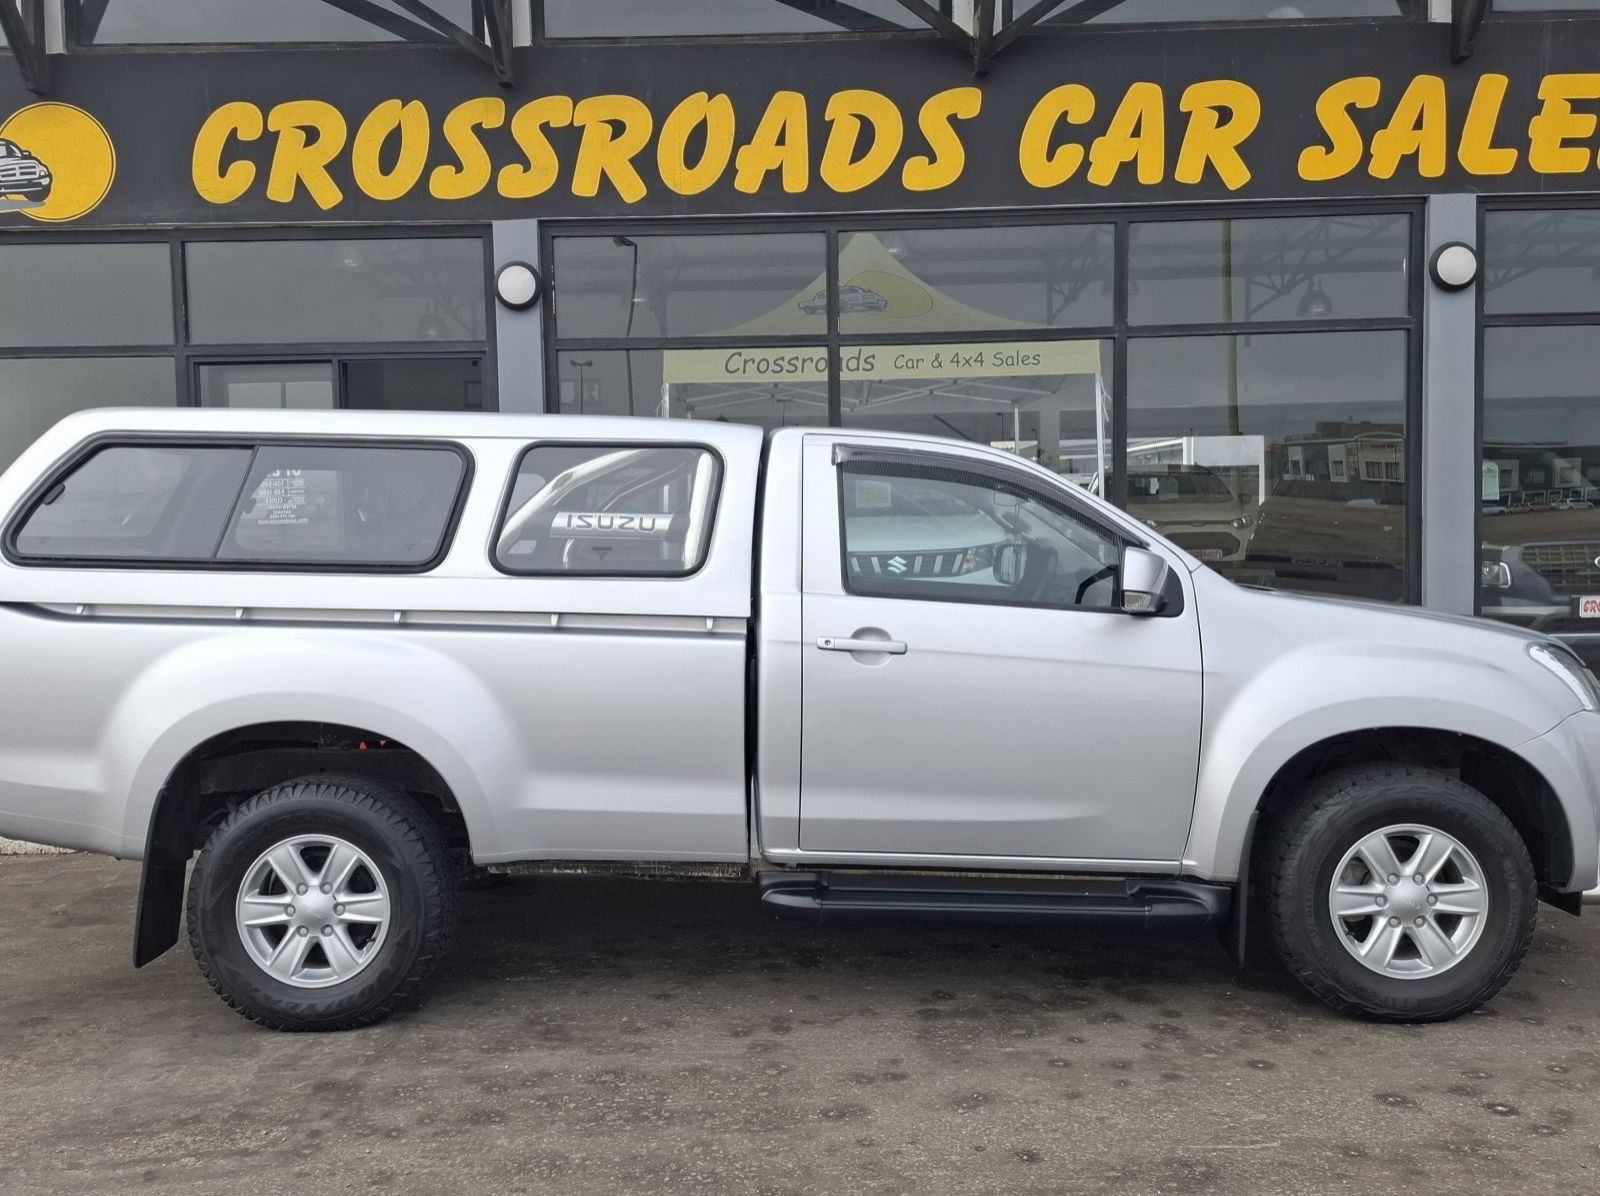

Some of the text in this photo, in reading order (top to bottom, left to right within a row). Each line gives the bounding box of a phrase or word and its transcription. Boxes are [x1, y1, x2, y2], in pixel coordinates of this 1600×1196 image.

[191, 72, 1600, 211] CROSSROADS CAR SALE
[724, 348, 1042, 375] Crossrods Car & 4x4 Sales
[566, 513, 656, 533] ISUZU
